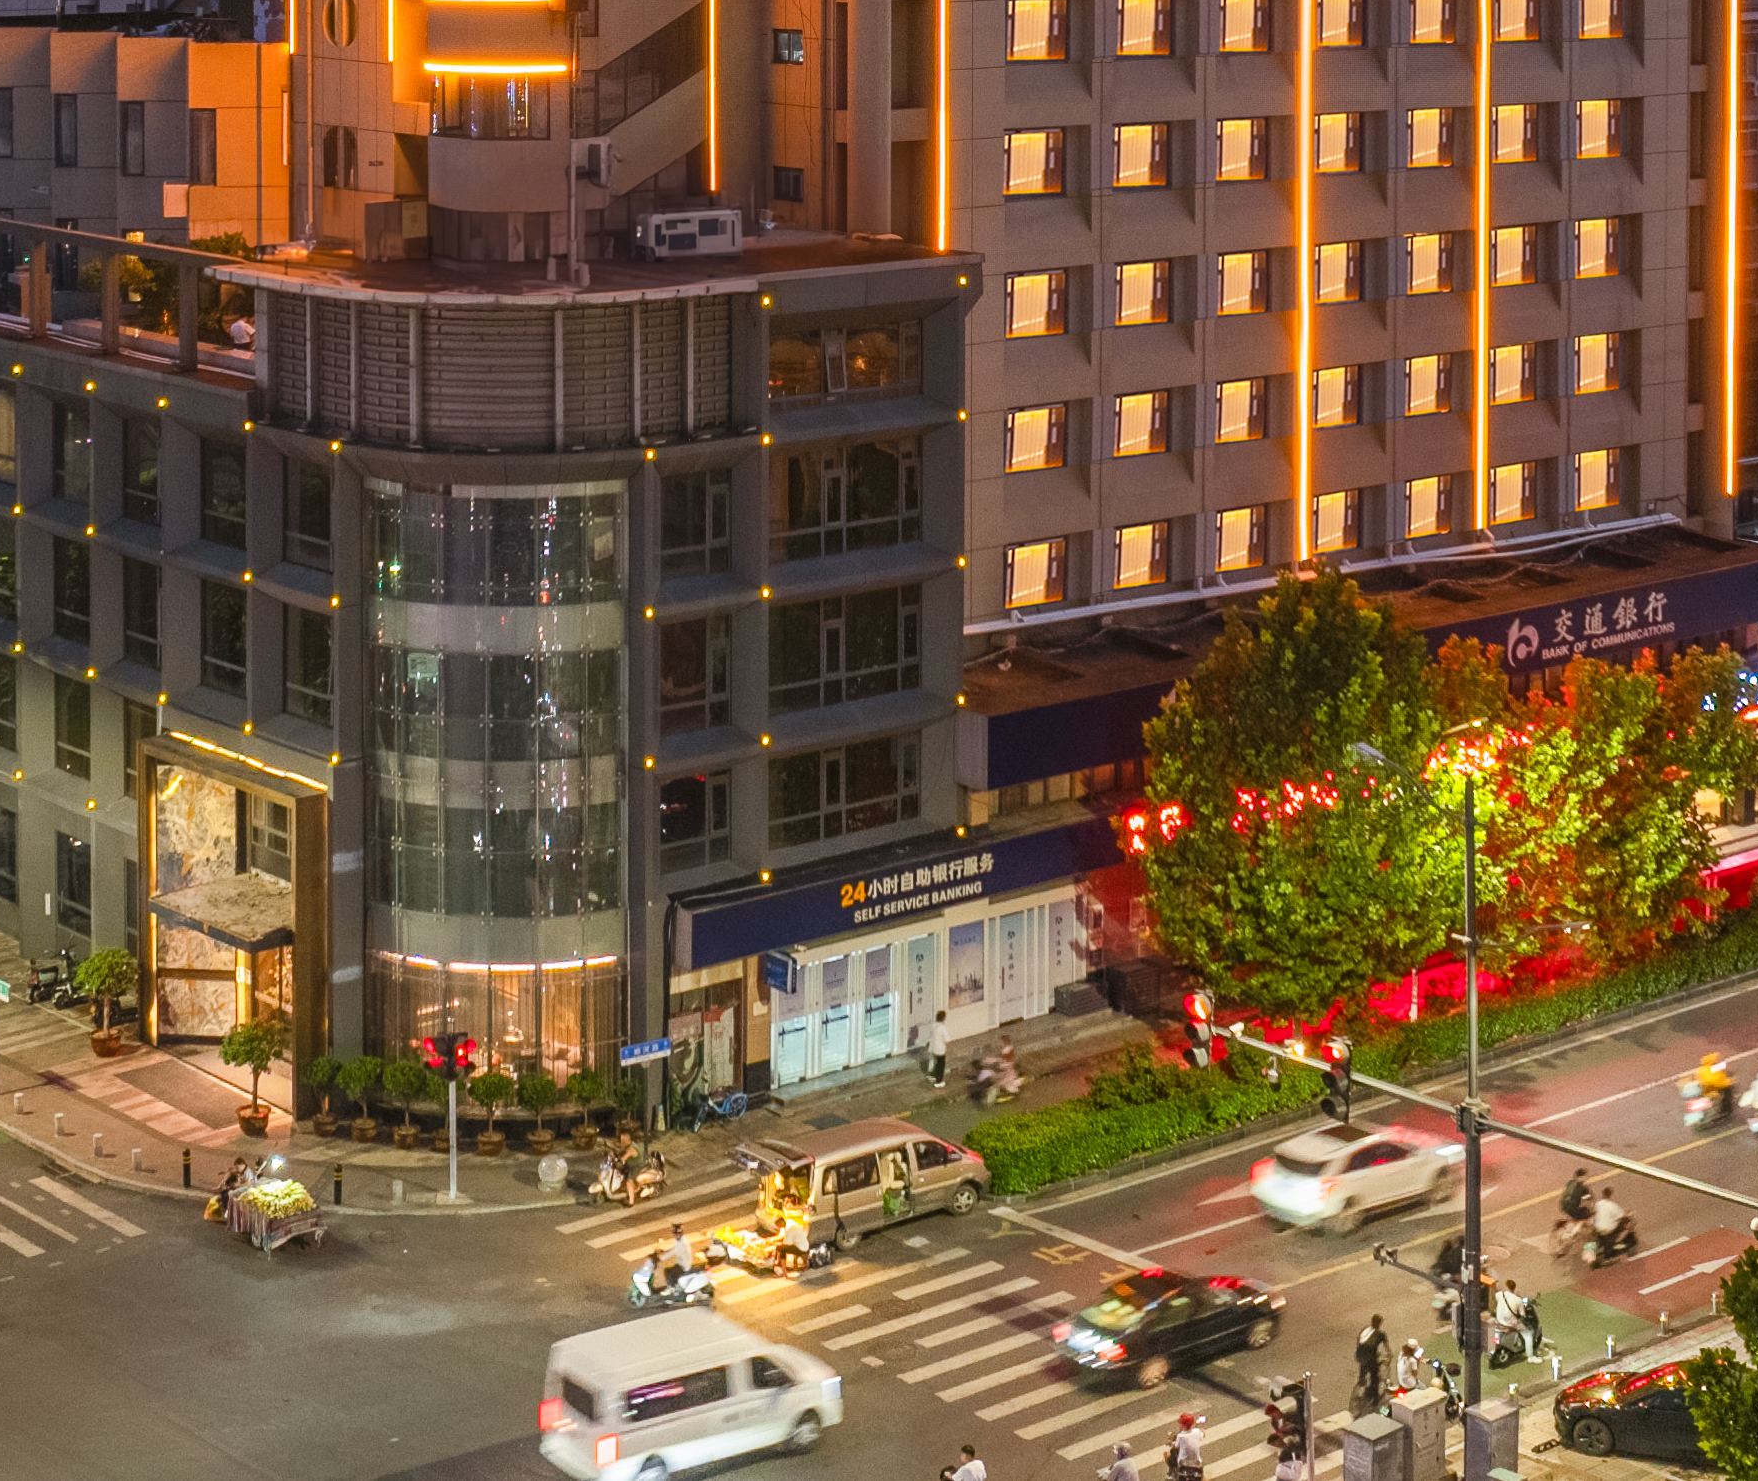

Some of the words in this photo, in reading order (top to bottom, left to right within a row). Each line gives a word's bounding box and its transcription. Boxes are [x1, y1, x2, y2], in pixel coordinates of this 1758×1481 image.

[1552, 591, 1668, 643] 交通銀行
[1541, 643, 1570, 660] BANK
[1573, 640, 1588, 653] OF
[1591, 622, 1676, 650] COMMUNICATIONS
[840, 853, 995, 908] 24小时自助银行服务
[854, 905, 881, 924] SELF
[883, 893, 930, 917] SERVICE
[931, 881, 982, 904] BANKING
